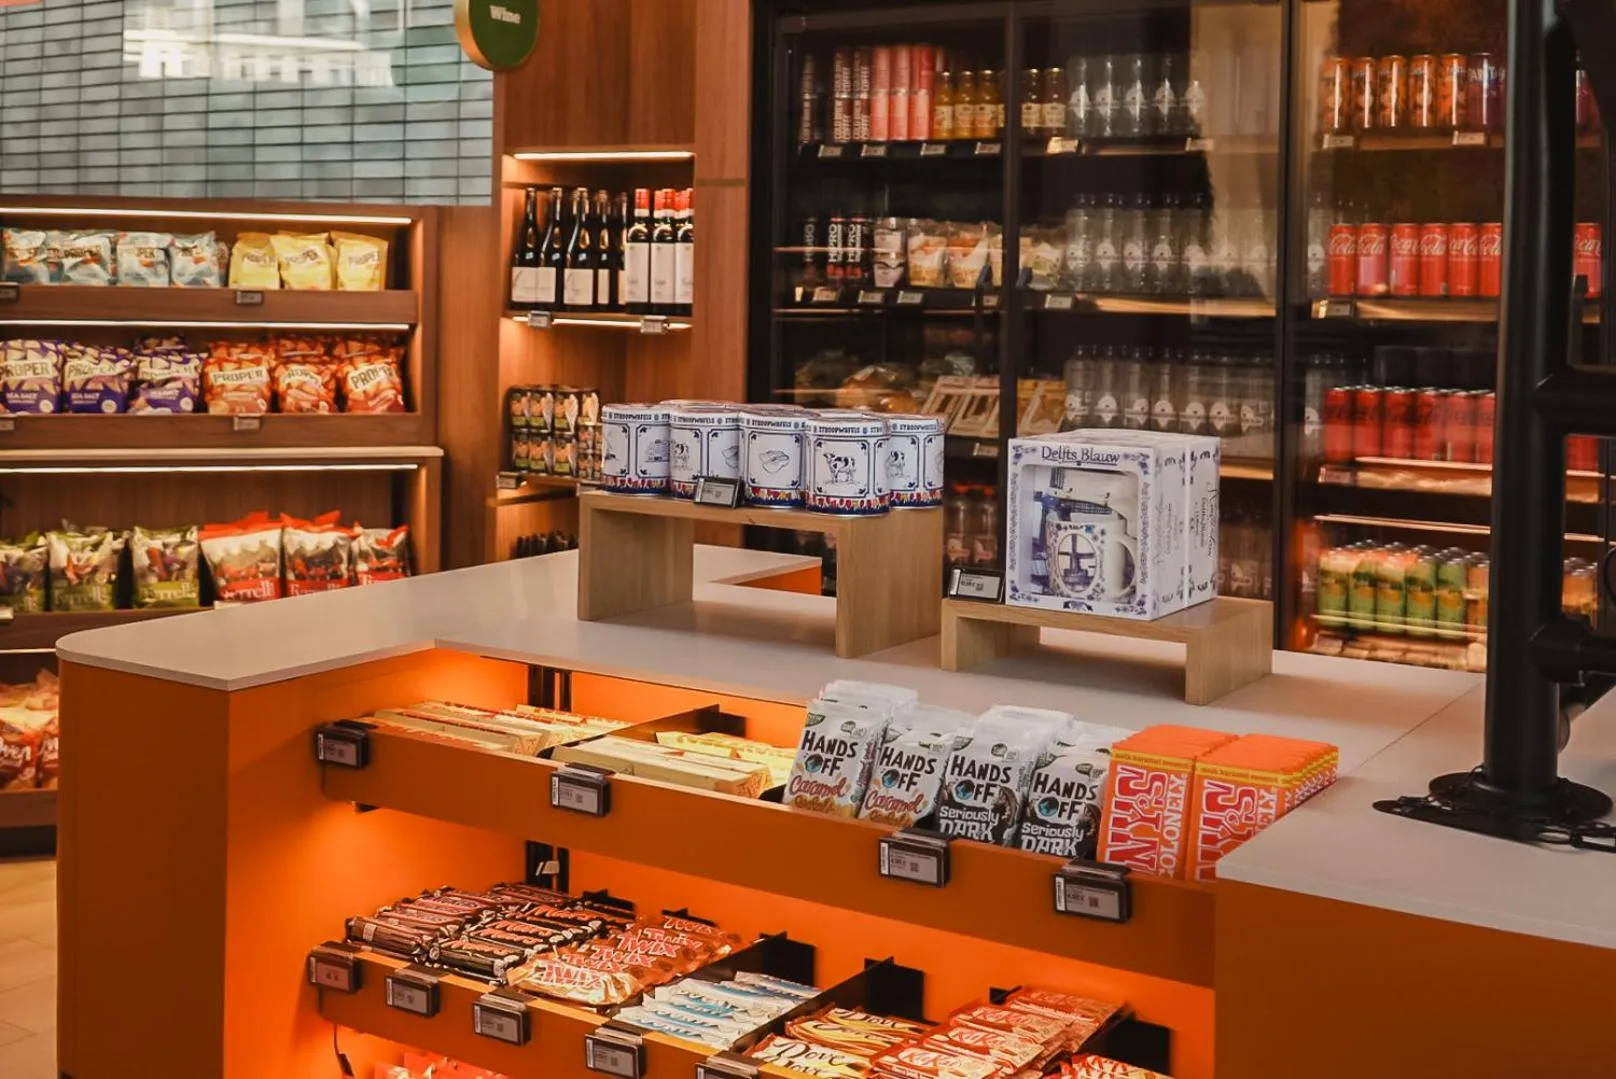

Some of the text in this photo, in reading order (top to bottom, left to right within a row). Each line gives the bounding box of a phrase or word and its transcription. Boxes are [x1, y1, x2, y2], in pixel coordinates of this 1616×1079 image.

[489, 4, 521, 25] Wine
[213, 369, 264, 384] PROPER
[1041, 445, 1121, 463] Delfts Blauw
[800, 729, 859, 759] HANDS
[803, 752, 845, 777] OFF
[879, 745, 937, 775] HANDS
[950, 754, 1013, 784] HANDS
[788, 774, 848, 799] Caramel
[881, 768, 922, 793] OFF
[955, 780, 998, 804] OFF
[1032, 772, 1099, 801] HANDS
[864, 789, 925, 815] Caramel
[1037, 797, 1083, 821] OFF
[939, 818, 995, 843] DARK
[1020, 834, 1078, 858] DARK
[772, 1038, 847, 1067] Dove
